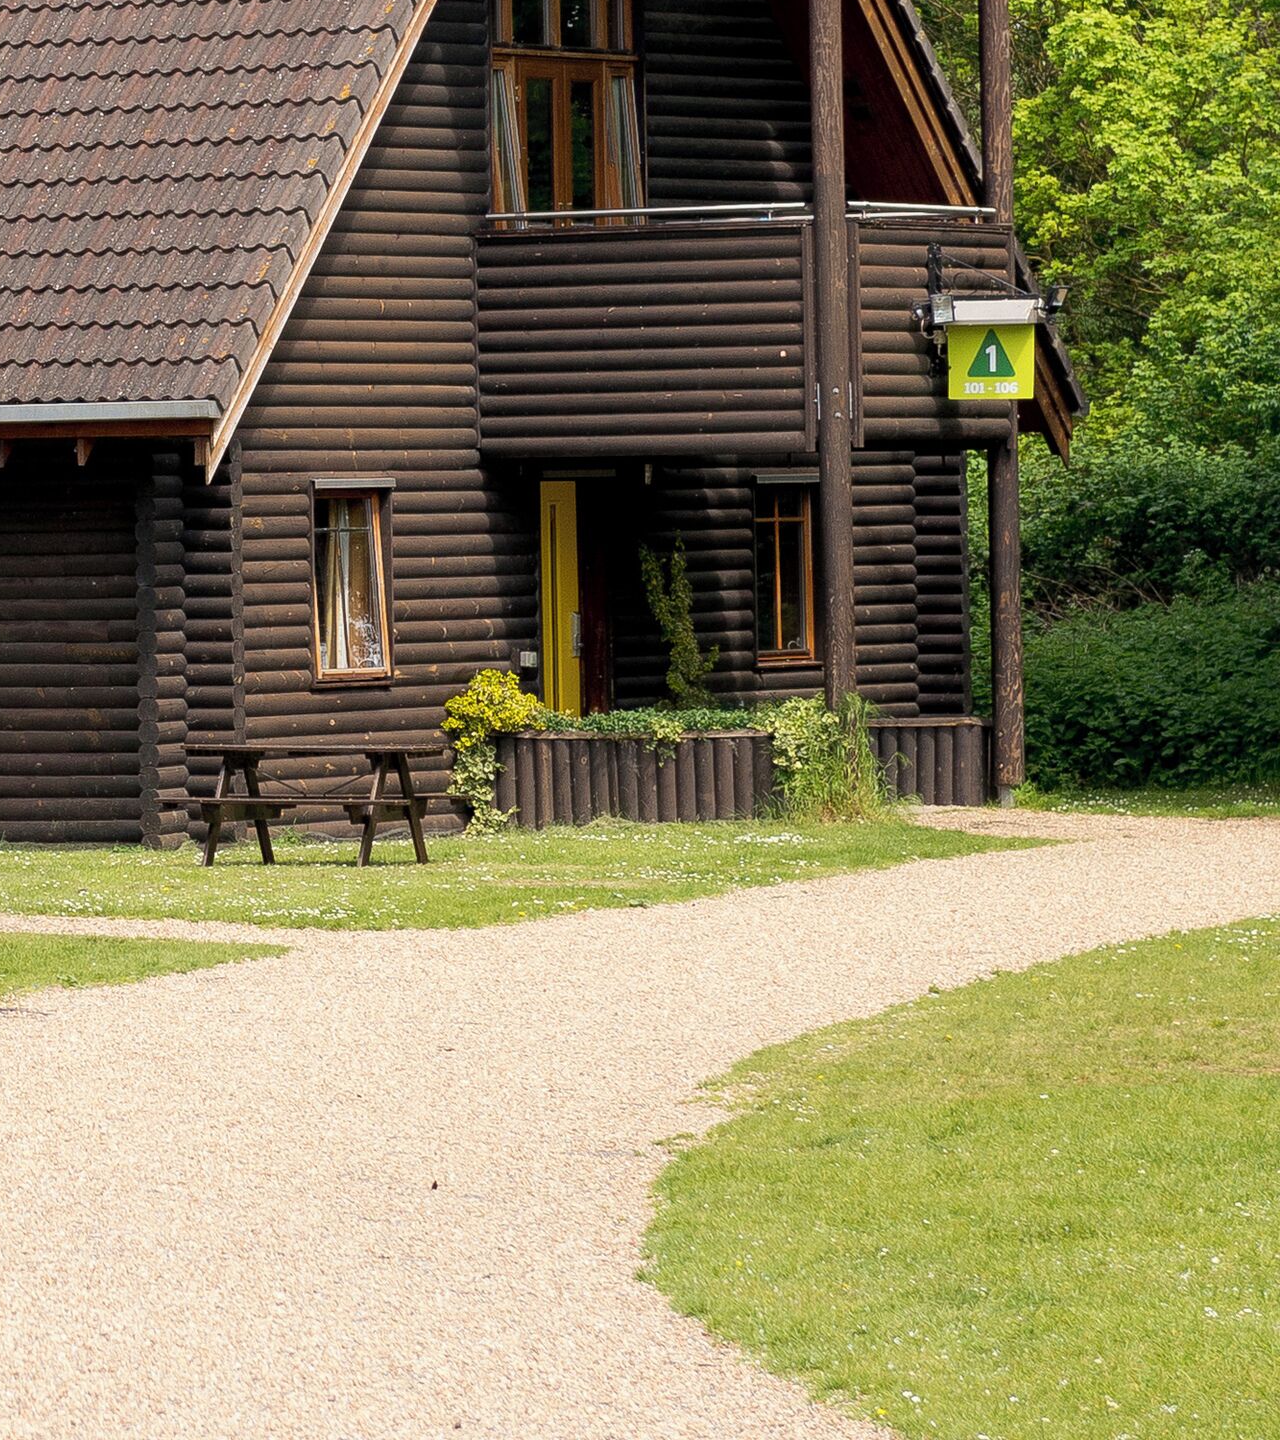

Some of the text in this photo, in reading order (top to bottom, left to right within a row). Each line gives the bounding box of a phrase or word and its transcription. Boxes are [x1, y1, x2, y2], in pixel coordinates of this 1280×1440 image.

[985, 345, 997, 372] 1
[964, 382, 985, 394] 101
[994, 382, 1018, 394] 106
